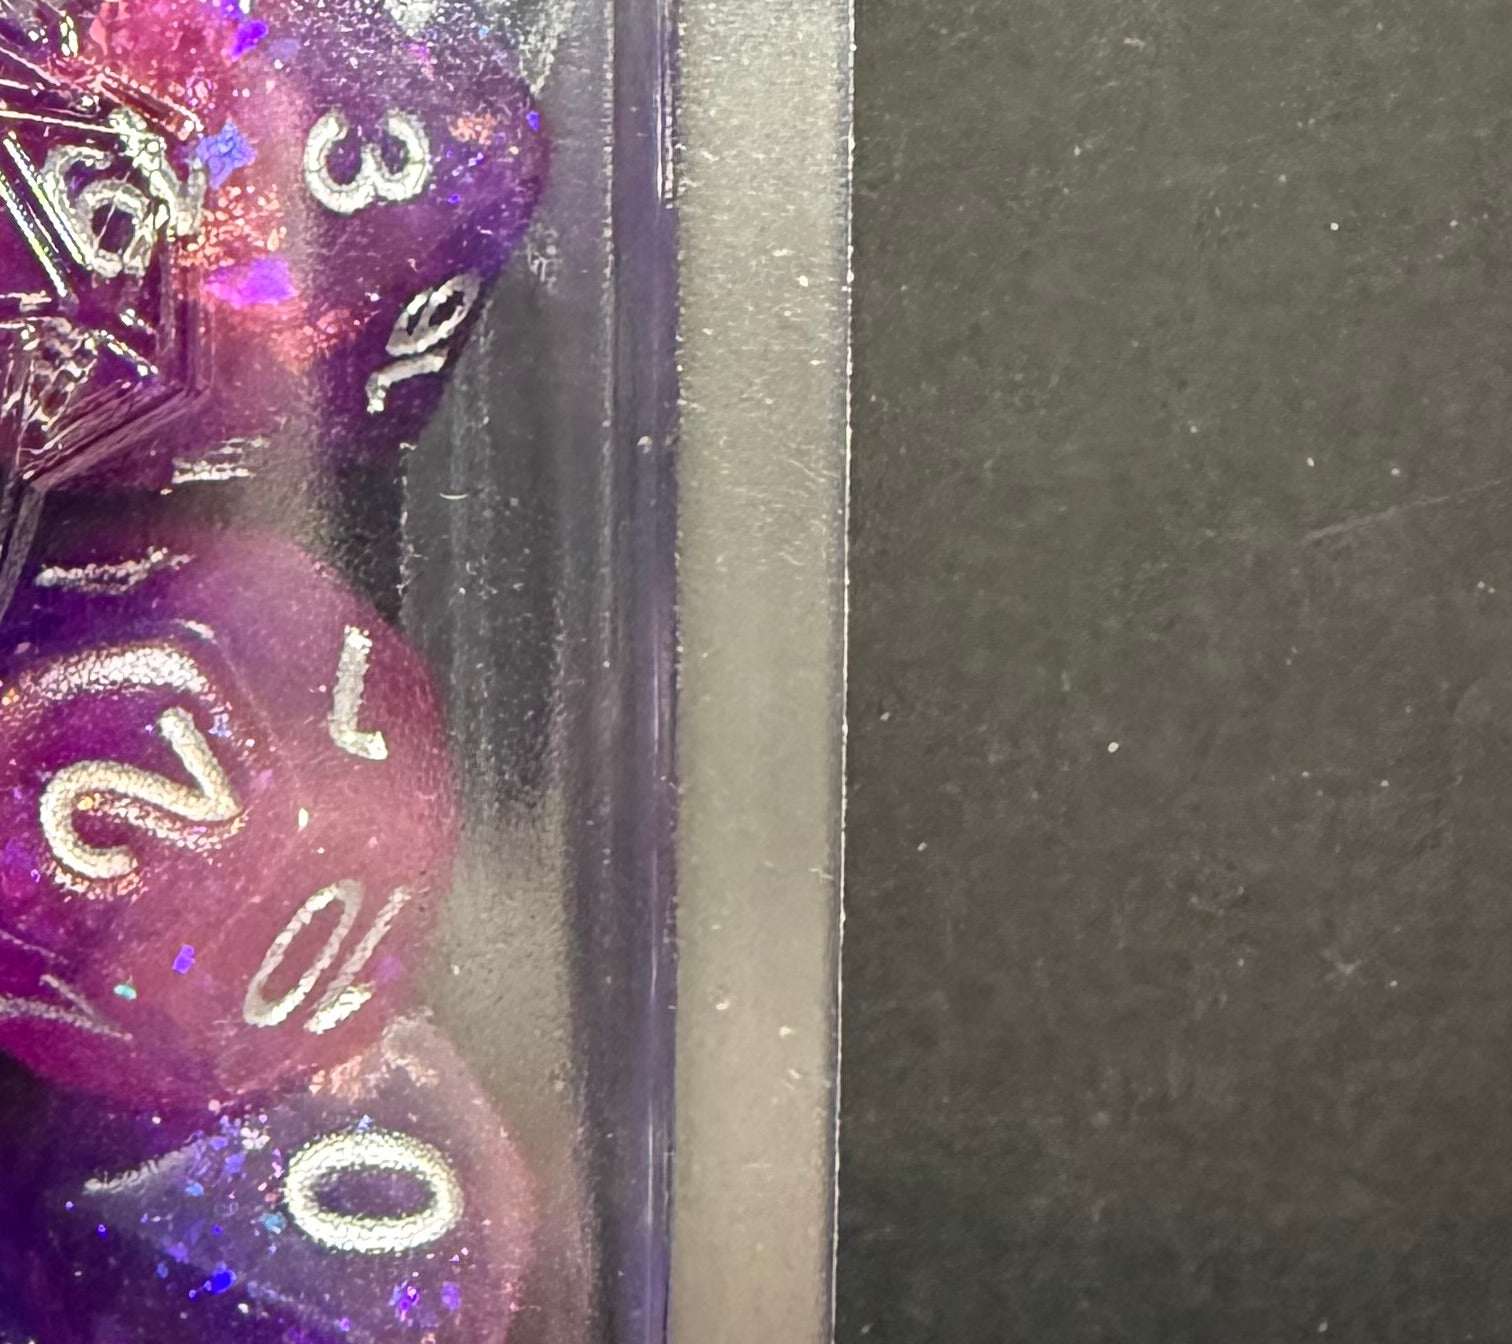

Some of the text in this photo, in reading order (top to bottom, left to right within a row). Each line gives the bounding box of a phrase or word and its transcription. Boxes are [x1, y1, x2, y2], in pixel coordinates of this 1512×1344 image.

[302, 108, 433, 216] 3
[39, 706, 245, 879] 2
[242, 878, 413, 1035] 10
[286, 1130, 465, 1254] 0
